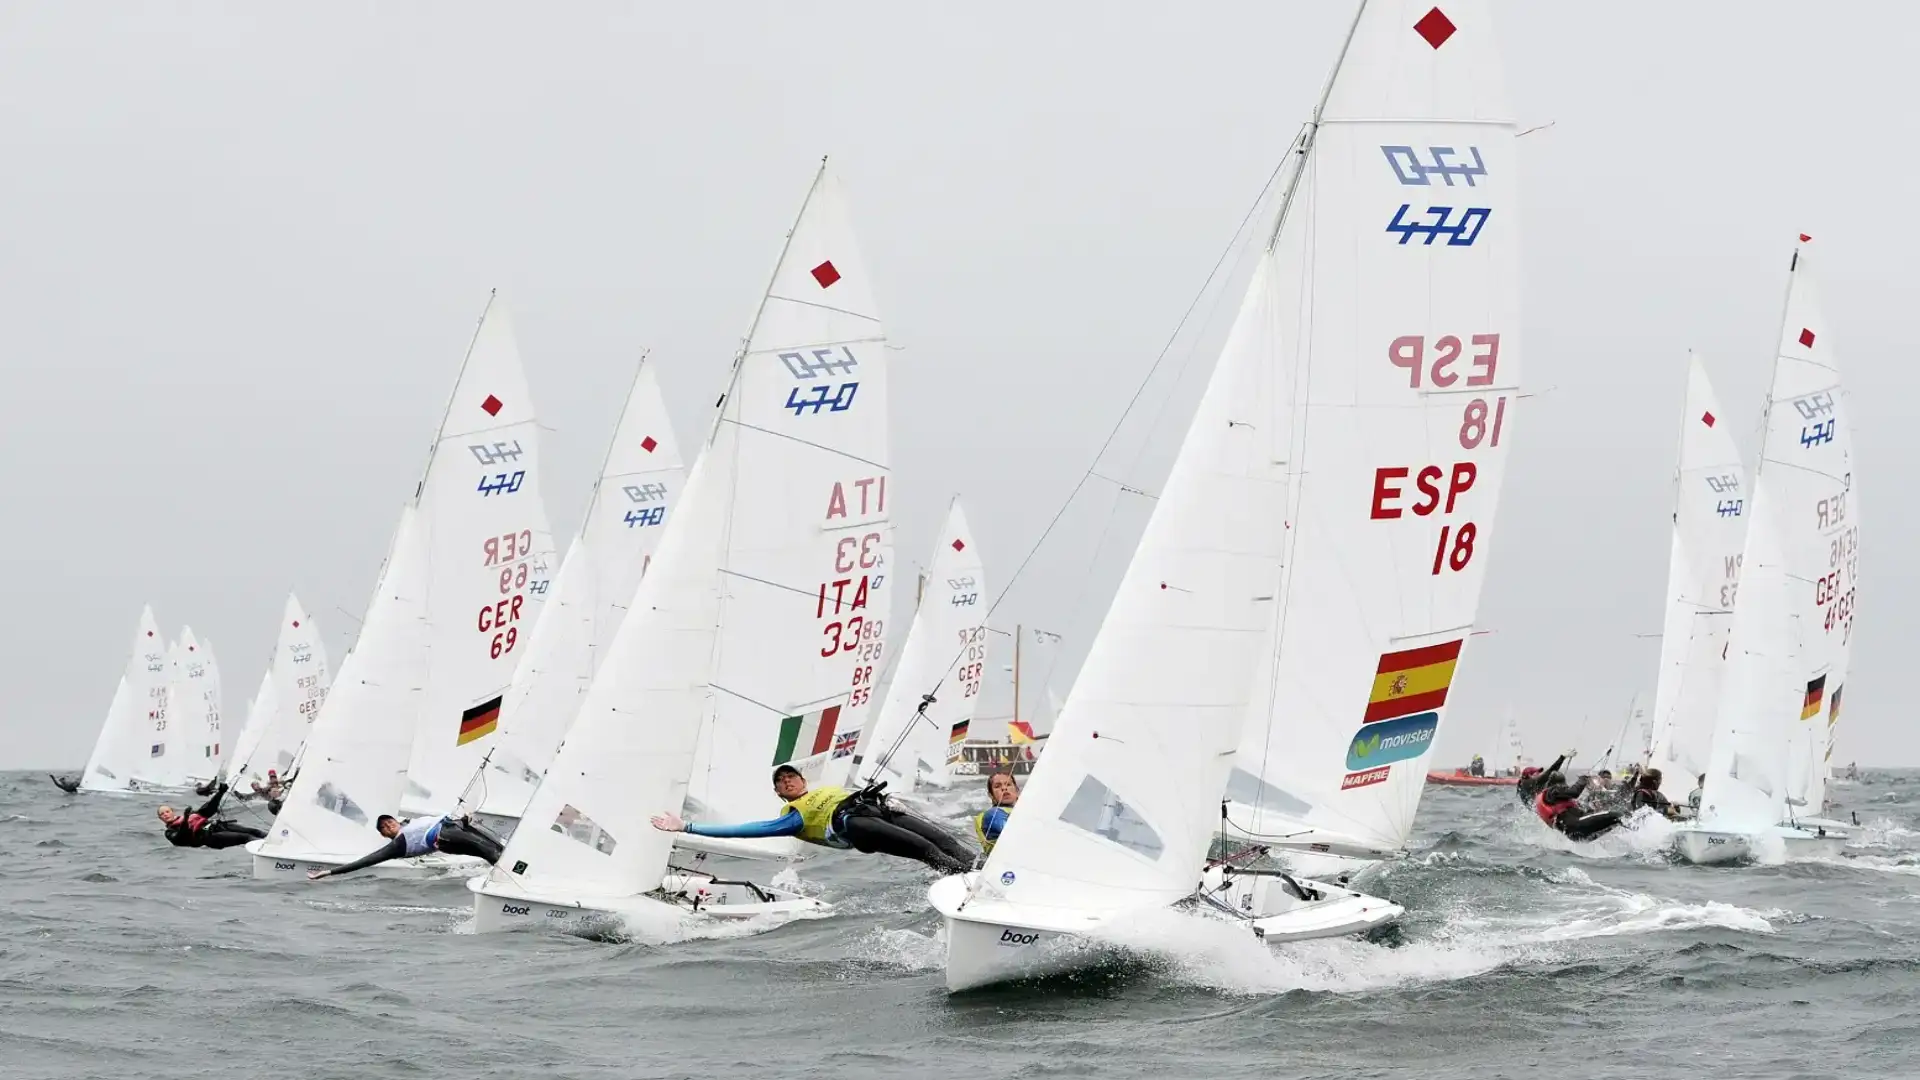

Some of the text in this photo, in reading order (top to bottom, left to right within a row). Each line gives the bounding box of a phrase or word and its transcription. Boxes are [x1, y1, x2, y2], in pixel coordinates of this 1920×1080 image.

[1385, 204, 1492, 246] 470
[785, 382, 859, 416] 470
[1800, 418, 1835, 449] 470
[477, 470, 526, 497] 470
[1370, 462, 1477, 520] ESP
[623, 507, 665, 528] 470
[1716, 499, 1743, 518] 470
[1432, 522, 1477, 575] 18
[530, 580, 550, 595] 70
[816, 575, 868, 619] ITA
[1816, 569, 1841, 607] GER
[478, 594, 523, 633] GER
[490, 627, 517, 660] 69
[821, 616, 863, 658] 33
[852, 666, 872, 686] BR
[958, 662, 982, 682] GER
[852, 687, 871, 707] 55
[964, 681, 980, 698] 20
[1380, 728, 1434, 750] movistar
[1343, 769, 1389, 786] MAPFRE
[502, 904, 531, 916] boot
[1000, 929, 1040, 945] boot
